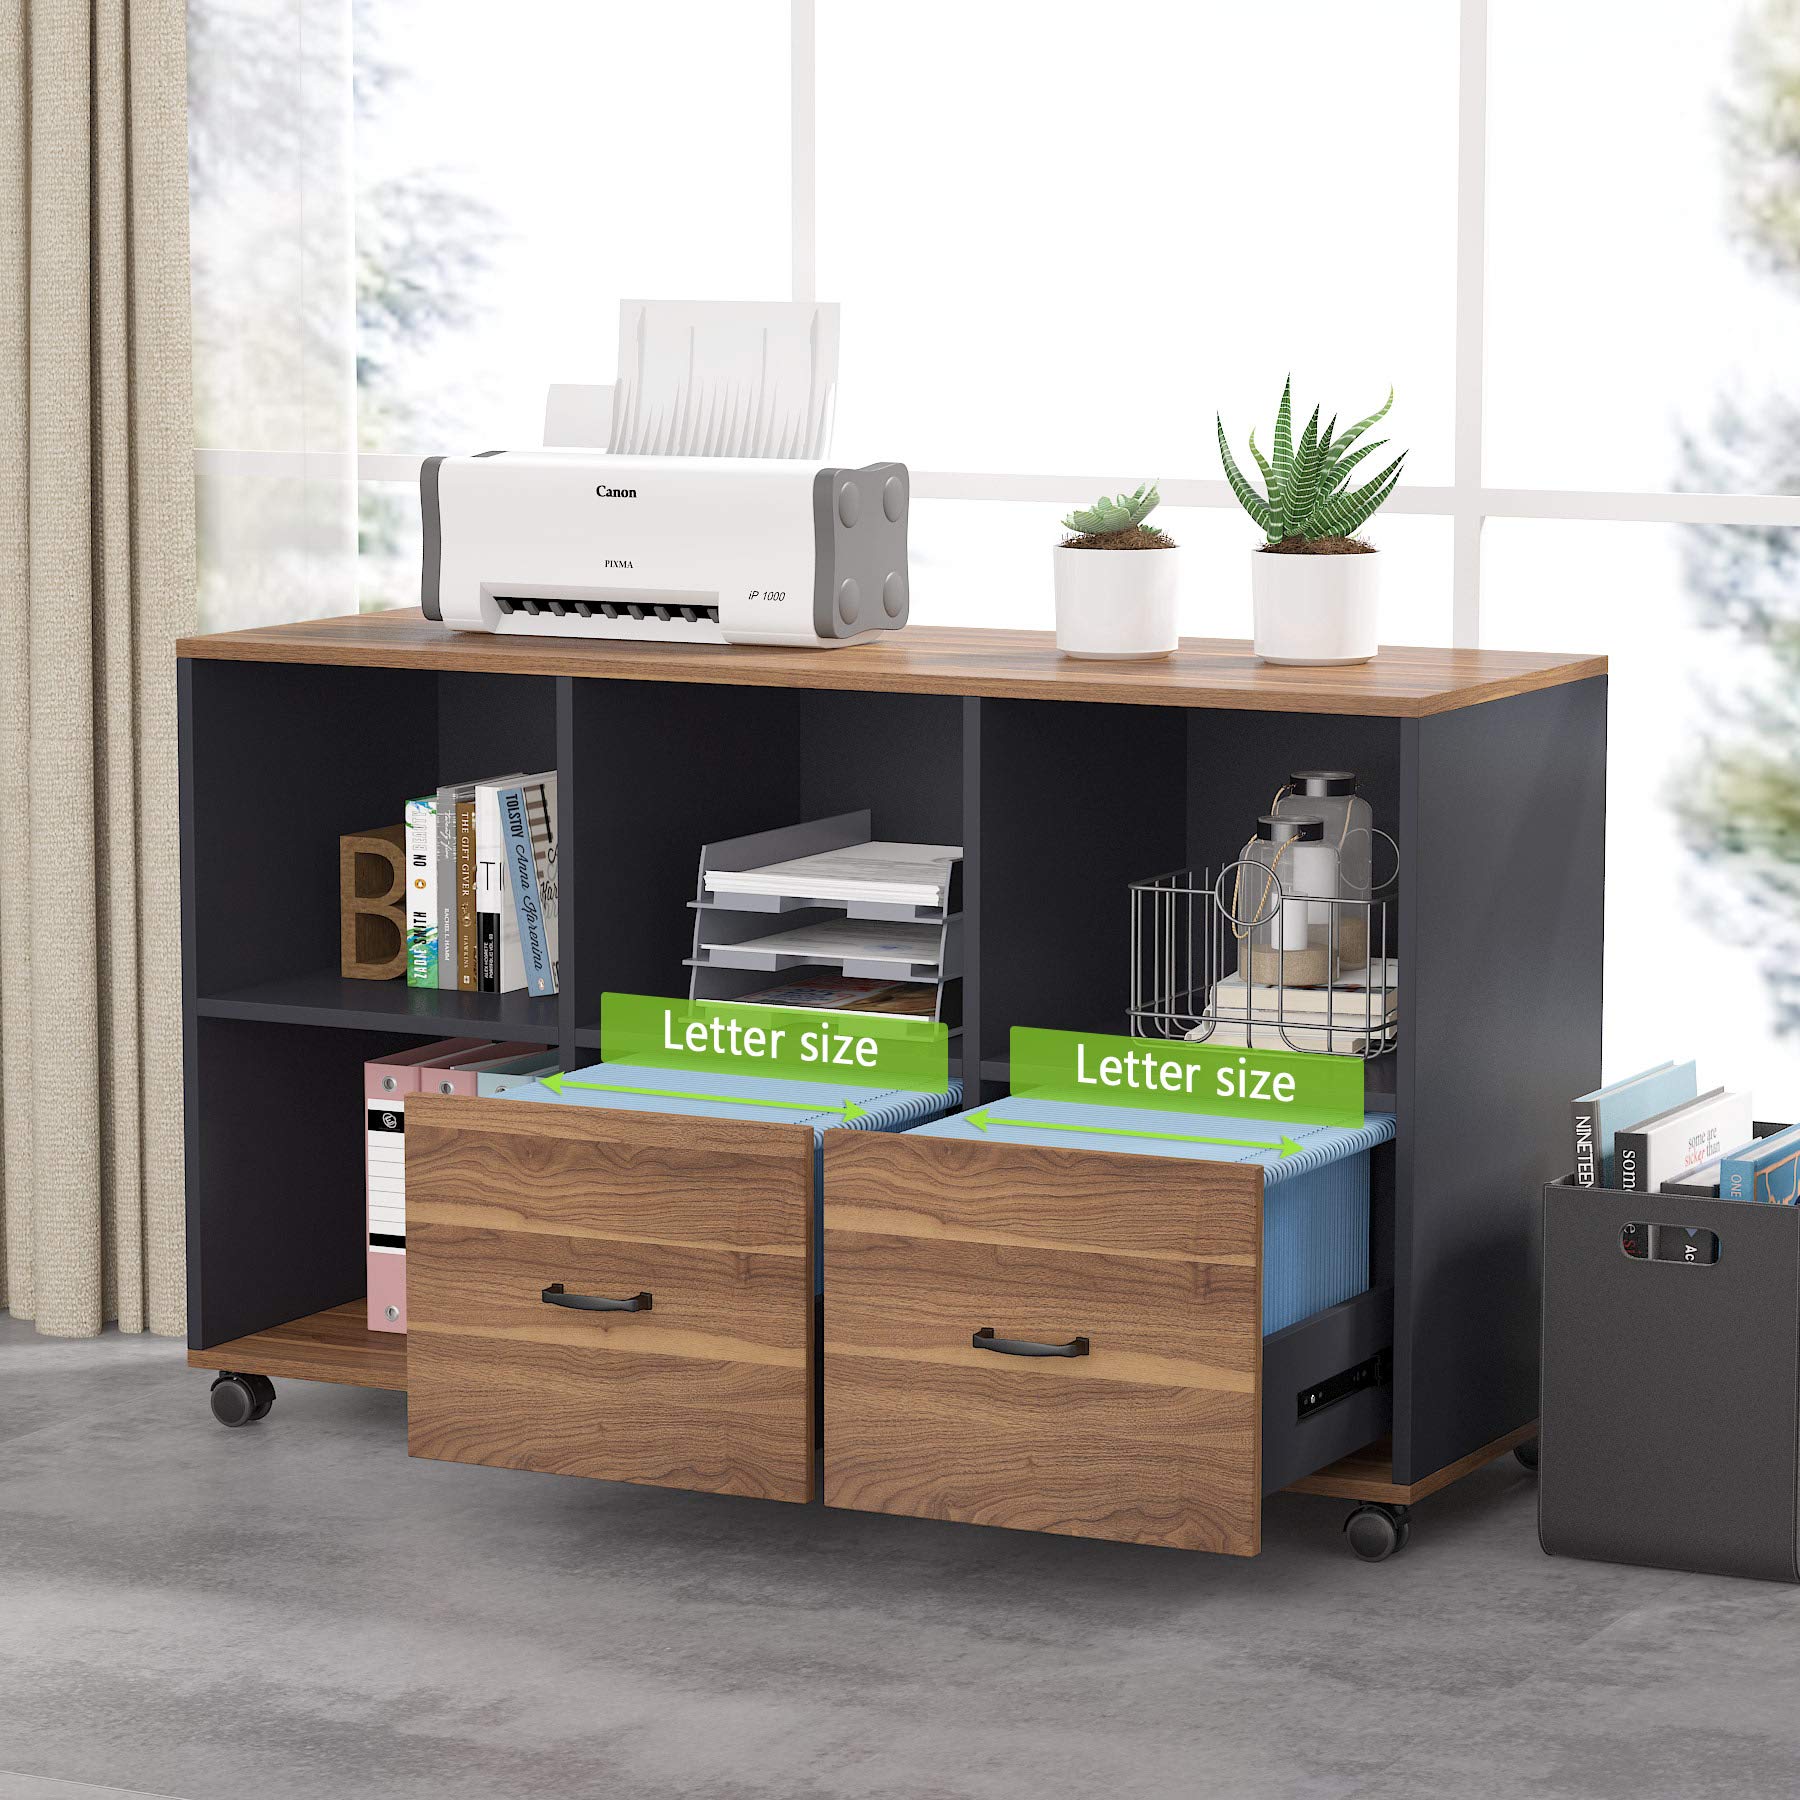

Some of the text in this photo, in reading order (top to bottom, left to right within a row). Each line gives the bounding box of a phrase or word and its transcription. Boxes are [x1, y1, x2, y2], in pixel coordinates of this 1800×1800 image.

[595, 485, 638, 499] Canon
[604, 559, 634, 569] PIXMA
[748, 590, 786, 602] iP 1000
[412, 811, 427, 867] ON BEAUTY
[461, 812, 470, 896] THE GIFT GIVER
[505, 793, 543, 971] TOLSTOY Anna Karenina
[413, 911, 428, 979] ZADIE SMITH
[1688, 1127, 1717, 1150] some are
[1622, 1149, 1636, 1191] som
[1731, 1174, 1742, 1198] ONE
